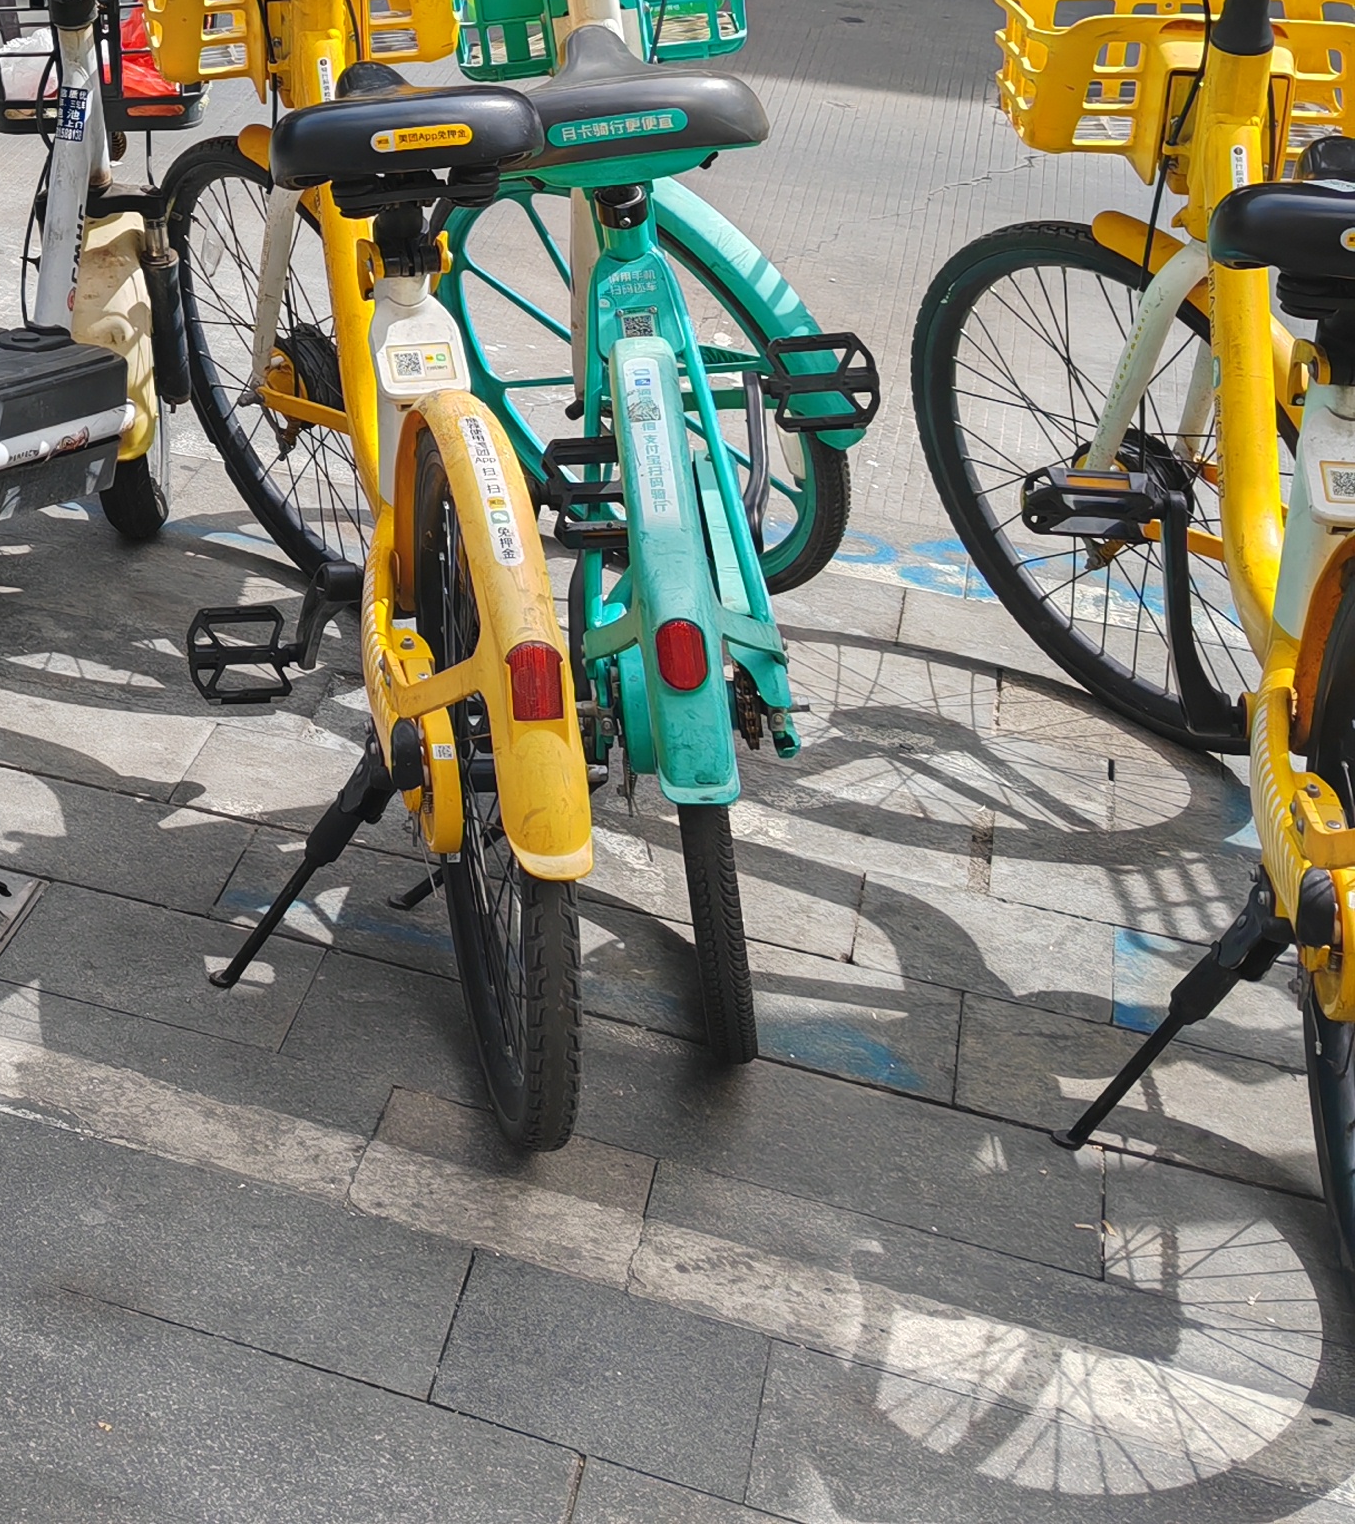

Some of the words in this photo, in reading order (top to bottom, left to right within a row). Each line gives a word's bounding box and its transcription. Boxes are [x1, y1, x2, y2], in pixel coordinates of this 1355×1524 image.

[561, 114, 674, 141] 月卡骑行更便宜
